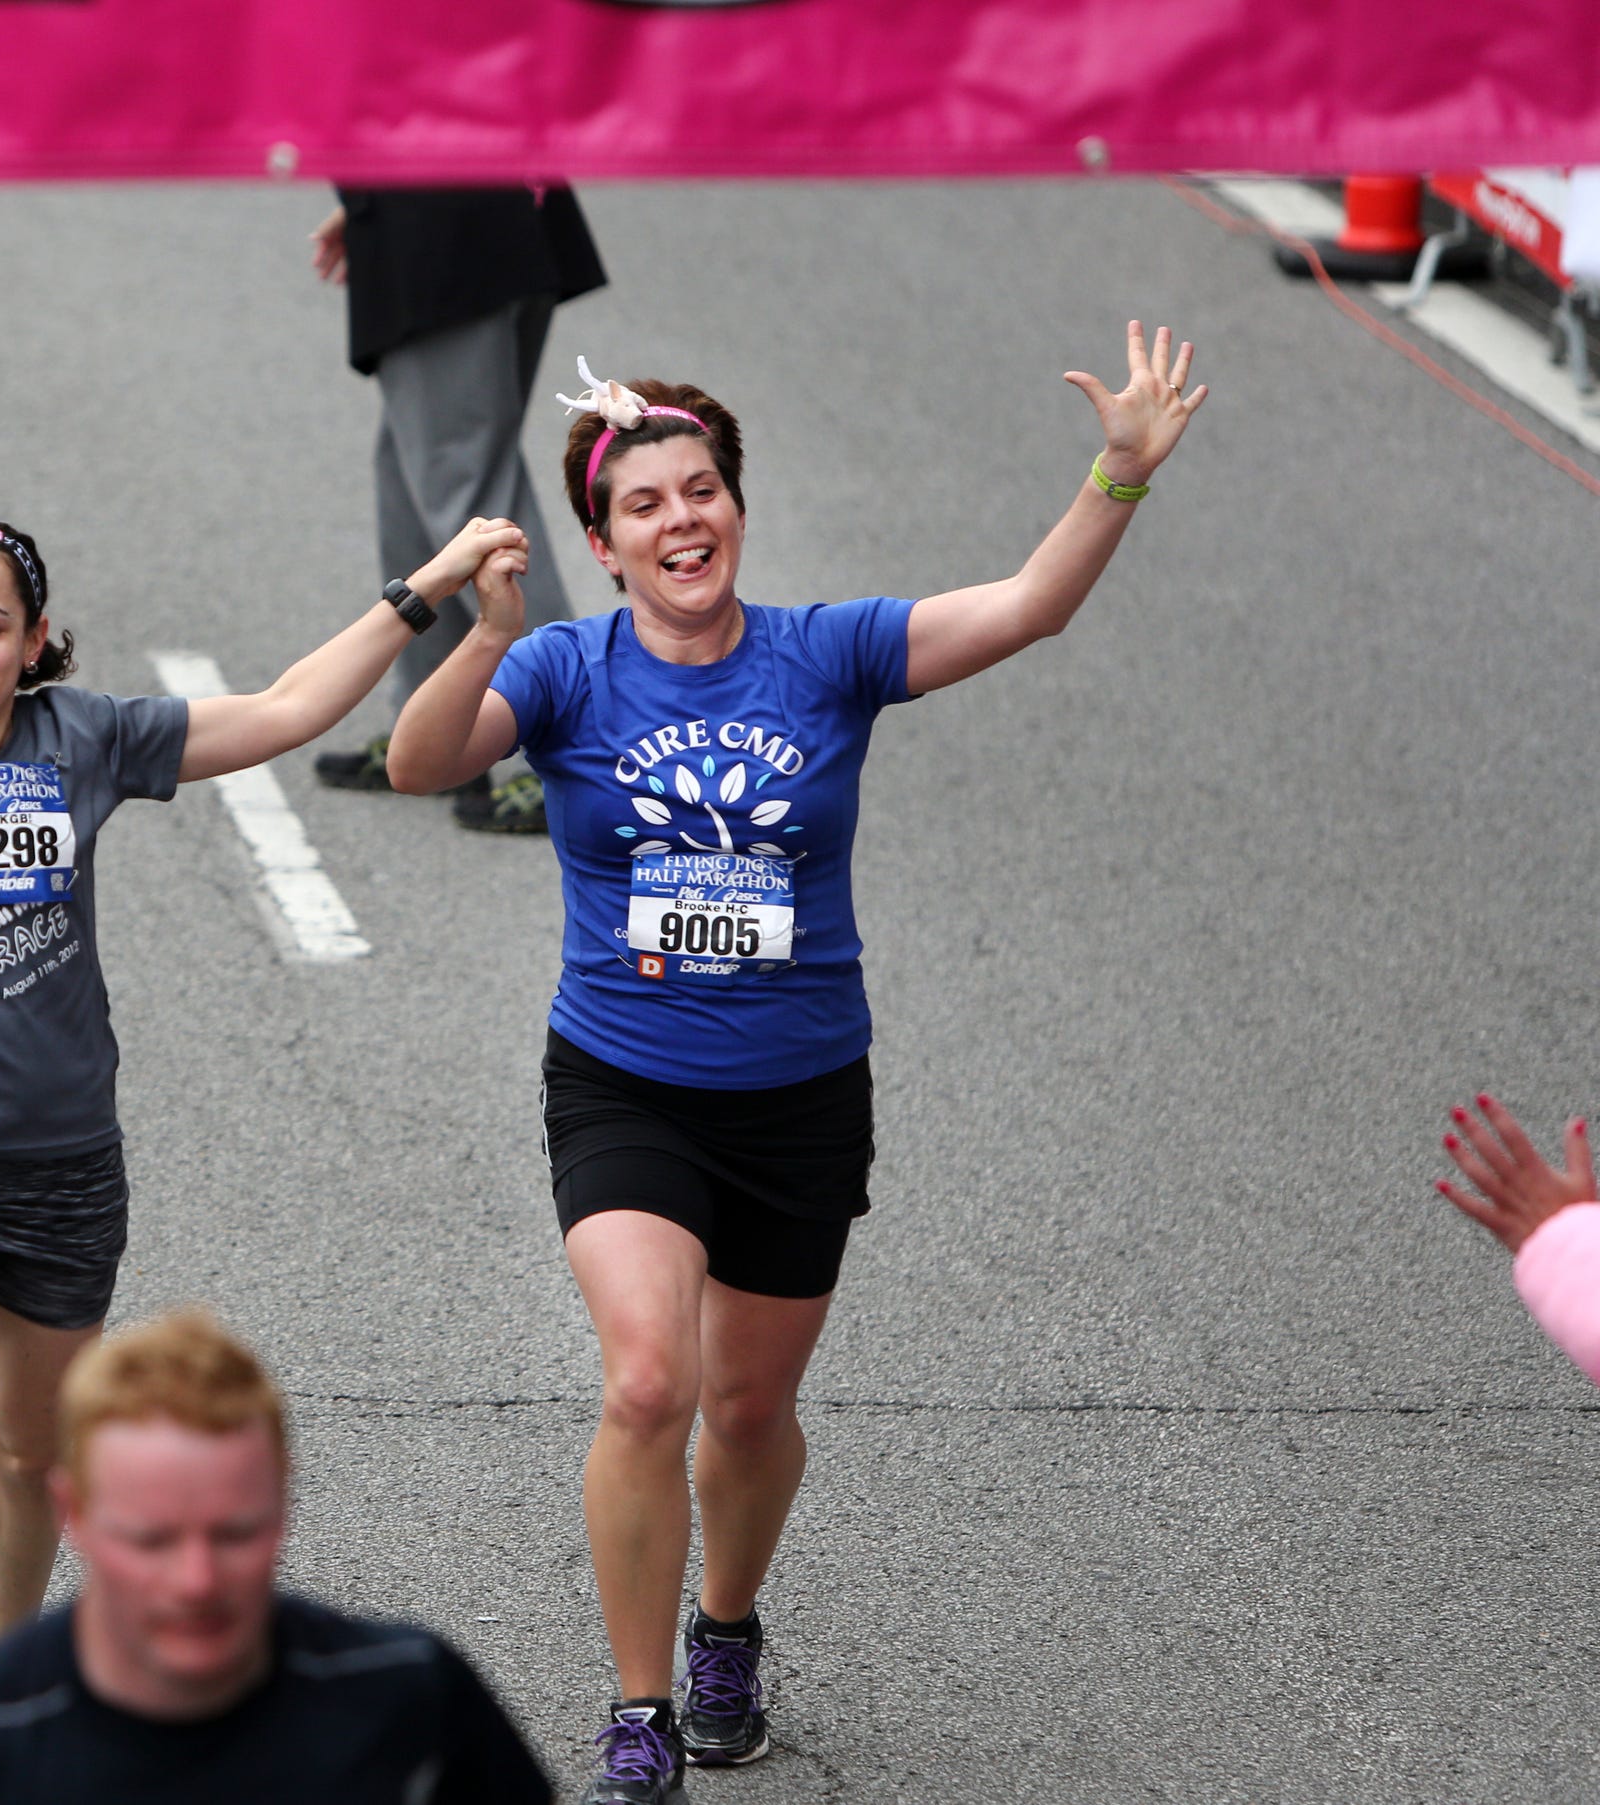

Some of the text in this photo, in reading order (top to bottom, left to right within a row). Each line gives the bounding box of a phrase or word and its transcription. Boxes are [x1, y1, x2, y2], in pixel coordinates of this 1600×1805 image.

[614, 719, 804, 784] CURE CMD
[11, 765, 37, 782] PIG
[0, 813, 32, 825] KGB!
[664, 855, 765, 874] FLYING PIG
[636, 868, 682, 884] HALF
[687, 872, 789, 891] MARATHON
[677, 886, 706, 900] P&G
[675, 900, 749, 914] Brooke H-C
[660, 912, 760, 957] 9005
[3, 970, 37, 999] August
[59, 940, 81, 963] 2012
[641, 958, 661, 975] D
